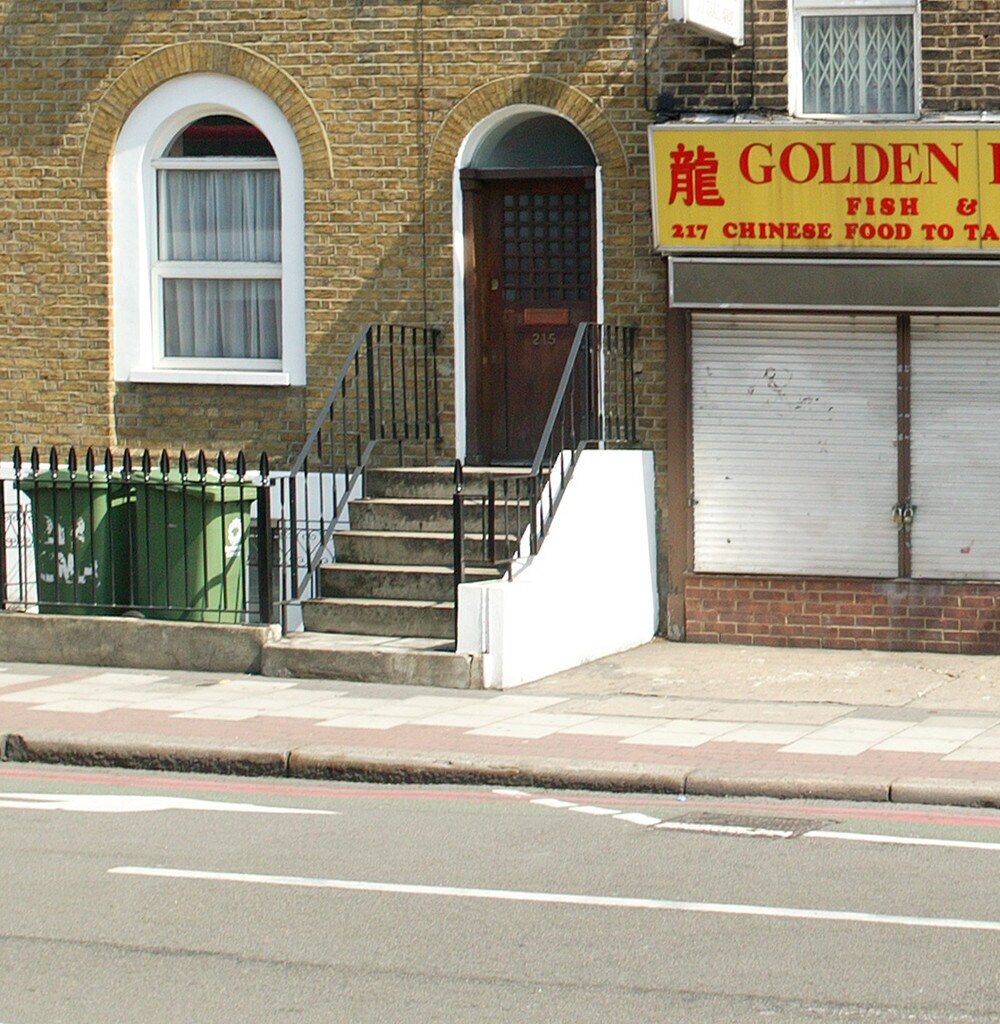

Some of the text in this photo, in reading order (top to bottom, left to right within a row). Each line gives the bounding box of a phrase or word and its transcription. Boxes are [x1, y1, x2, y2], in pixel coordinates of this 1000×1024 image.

[738, 141, 964, 186] GOLDEN
[669, 143, 726, 207] 龍
[847, 196, 920, 217] FISH
[956, 197, 979, 217] &
[673, 223, 709, 239] 217
[722, 221, 832, 240] CHINESE
[846, 222, 913, 241] FOOD
[922, 223, 955, 241] TO
[531, 332, 557, 346] 215
